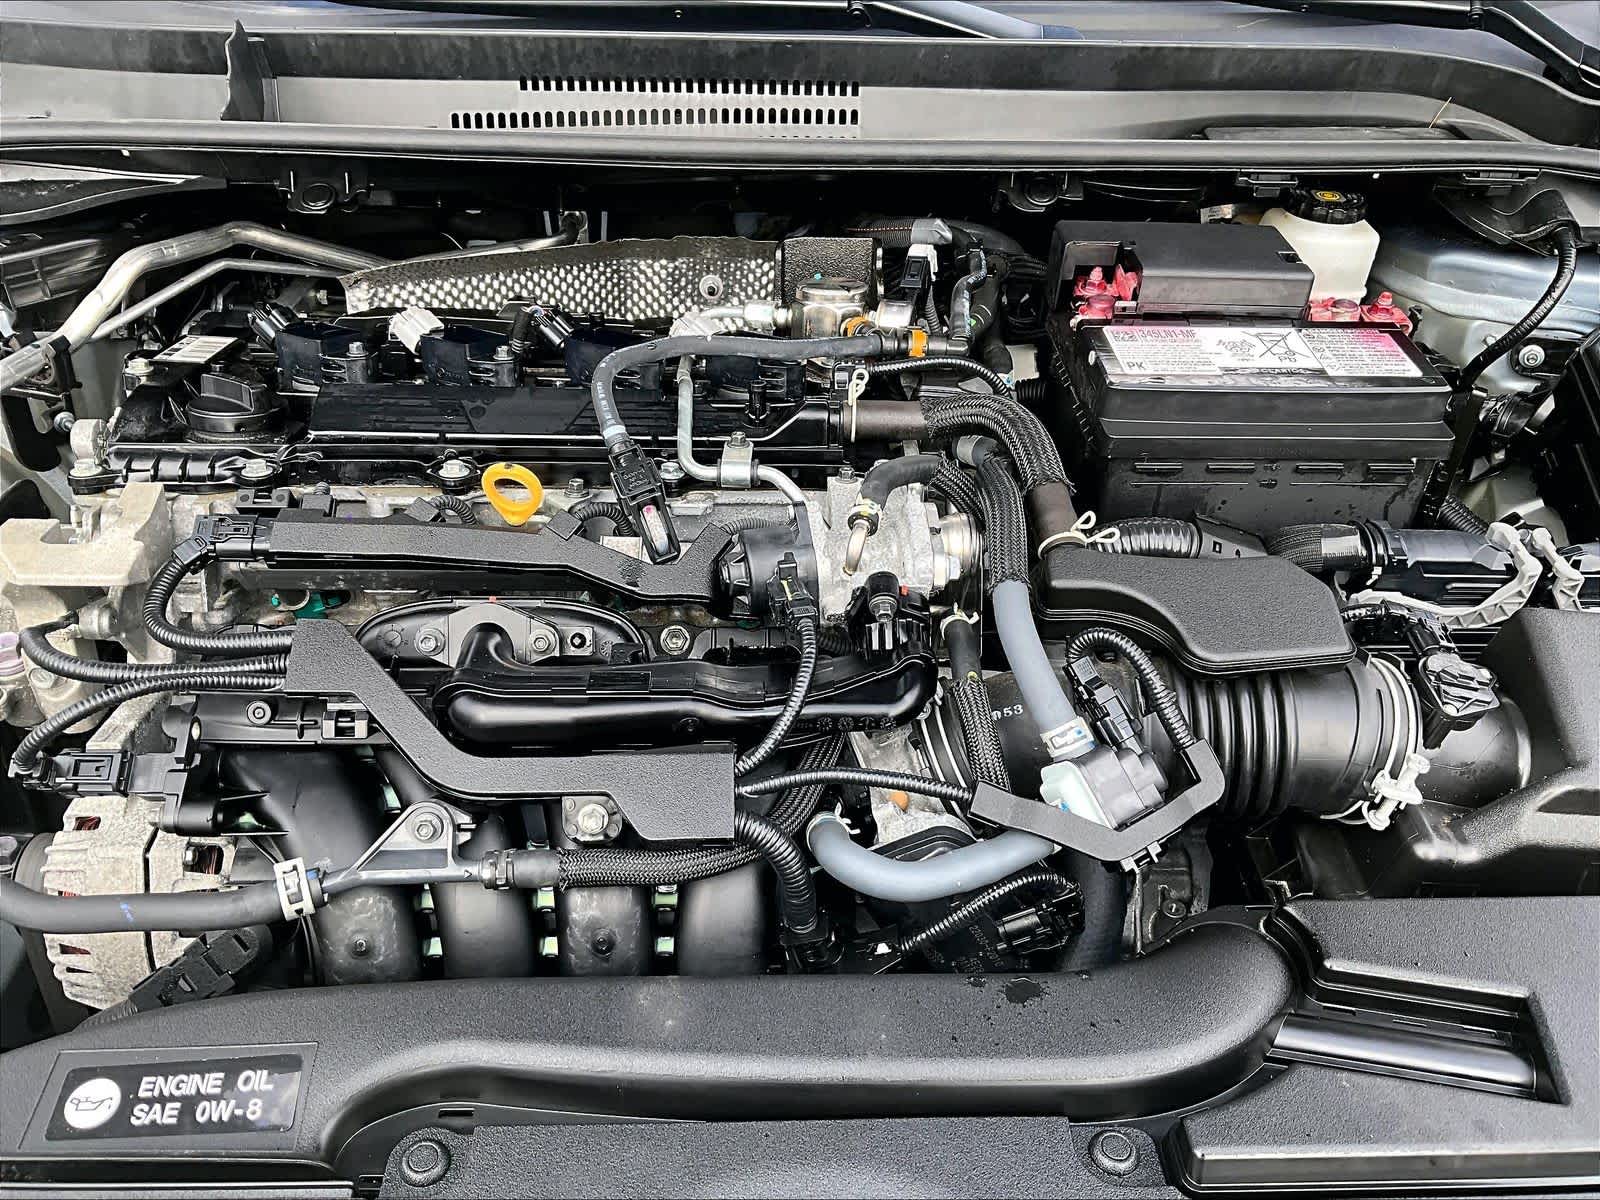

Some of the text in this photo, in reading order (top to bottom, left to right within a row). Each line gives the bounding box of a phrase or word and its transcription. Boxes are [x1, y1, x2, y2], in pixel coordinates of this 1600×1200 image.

[1126, 361, 1146, 371] PK
[138, 1070, 274, 1098] ENGINE OIL
[130, 1098, 263, 1126] SAE 0W-8
